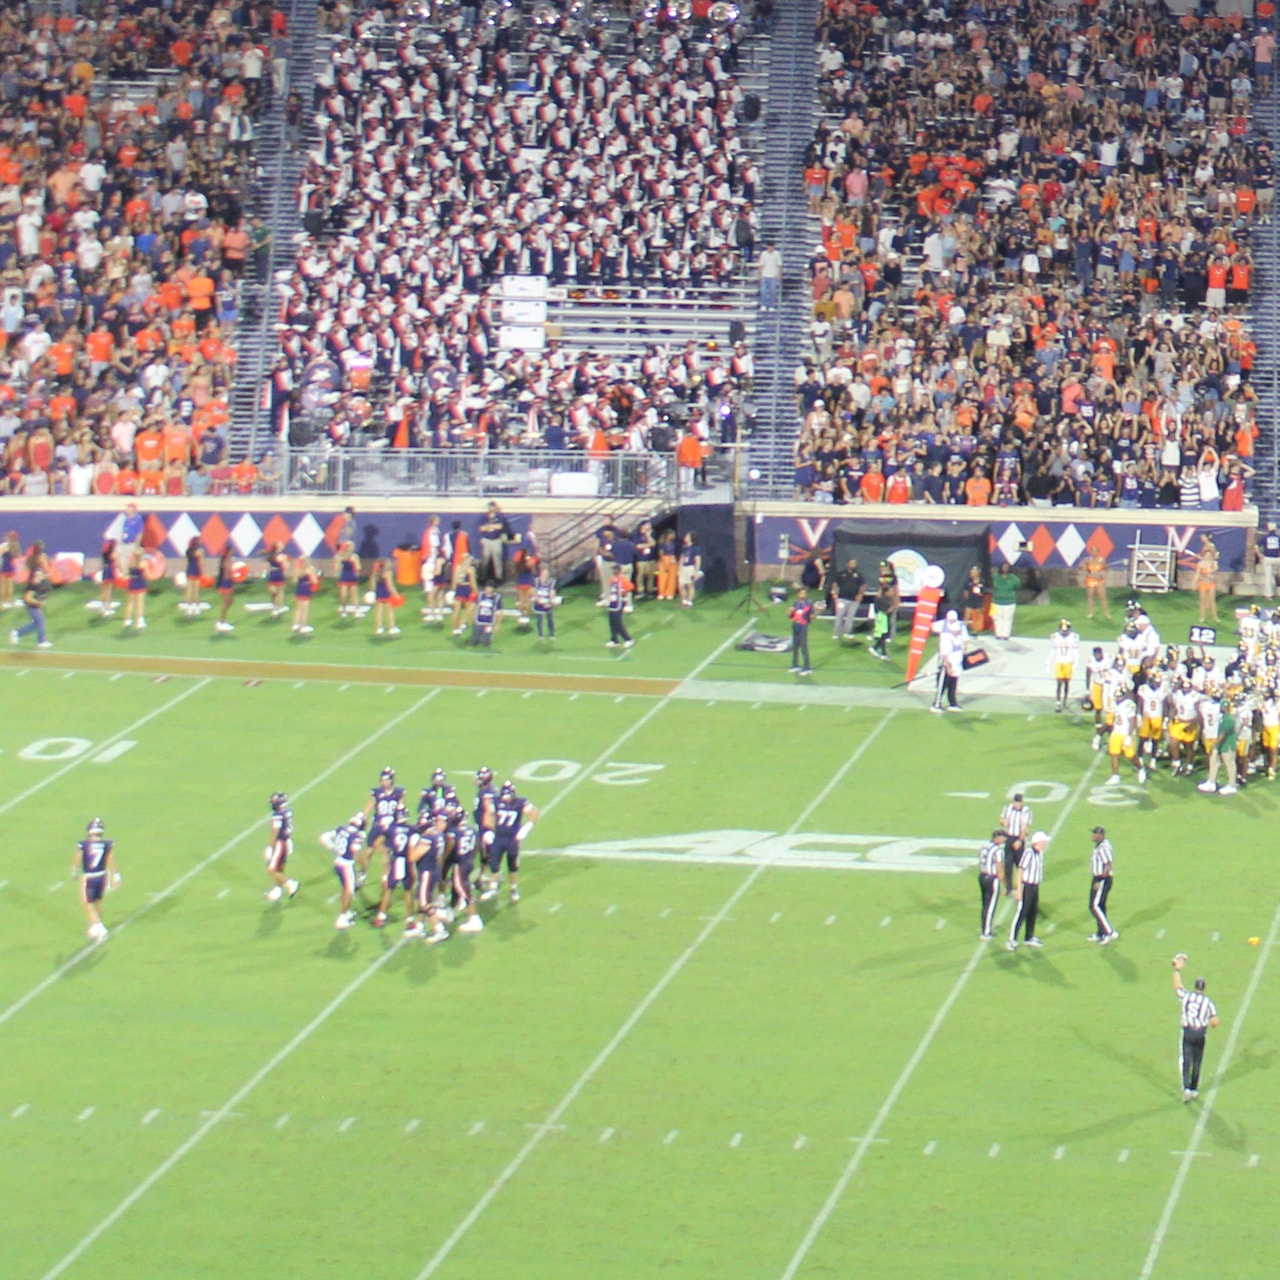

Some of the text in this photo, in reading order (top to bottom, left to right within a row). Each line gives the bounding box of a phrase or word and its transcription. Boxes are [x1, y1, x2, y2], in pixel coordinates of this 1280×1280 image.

[1190, 628, 1214, 643] 12
[512, 759, 666, 785] 20
[496, 809, 518, 827] 77
[395, 833, 409, 852] 9
[89, 848, 106, 869] 7
